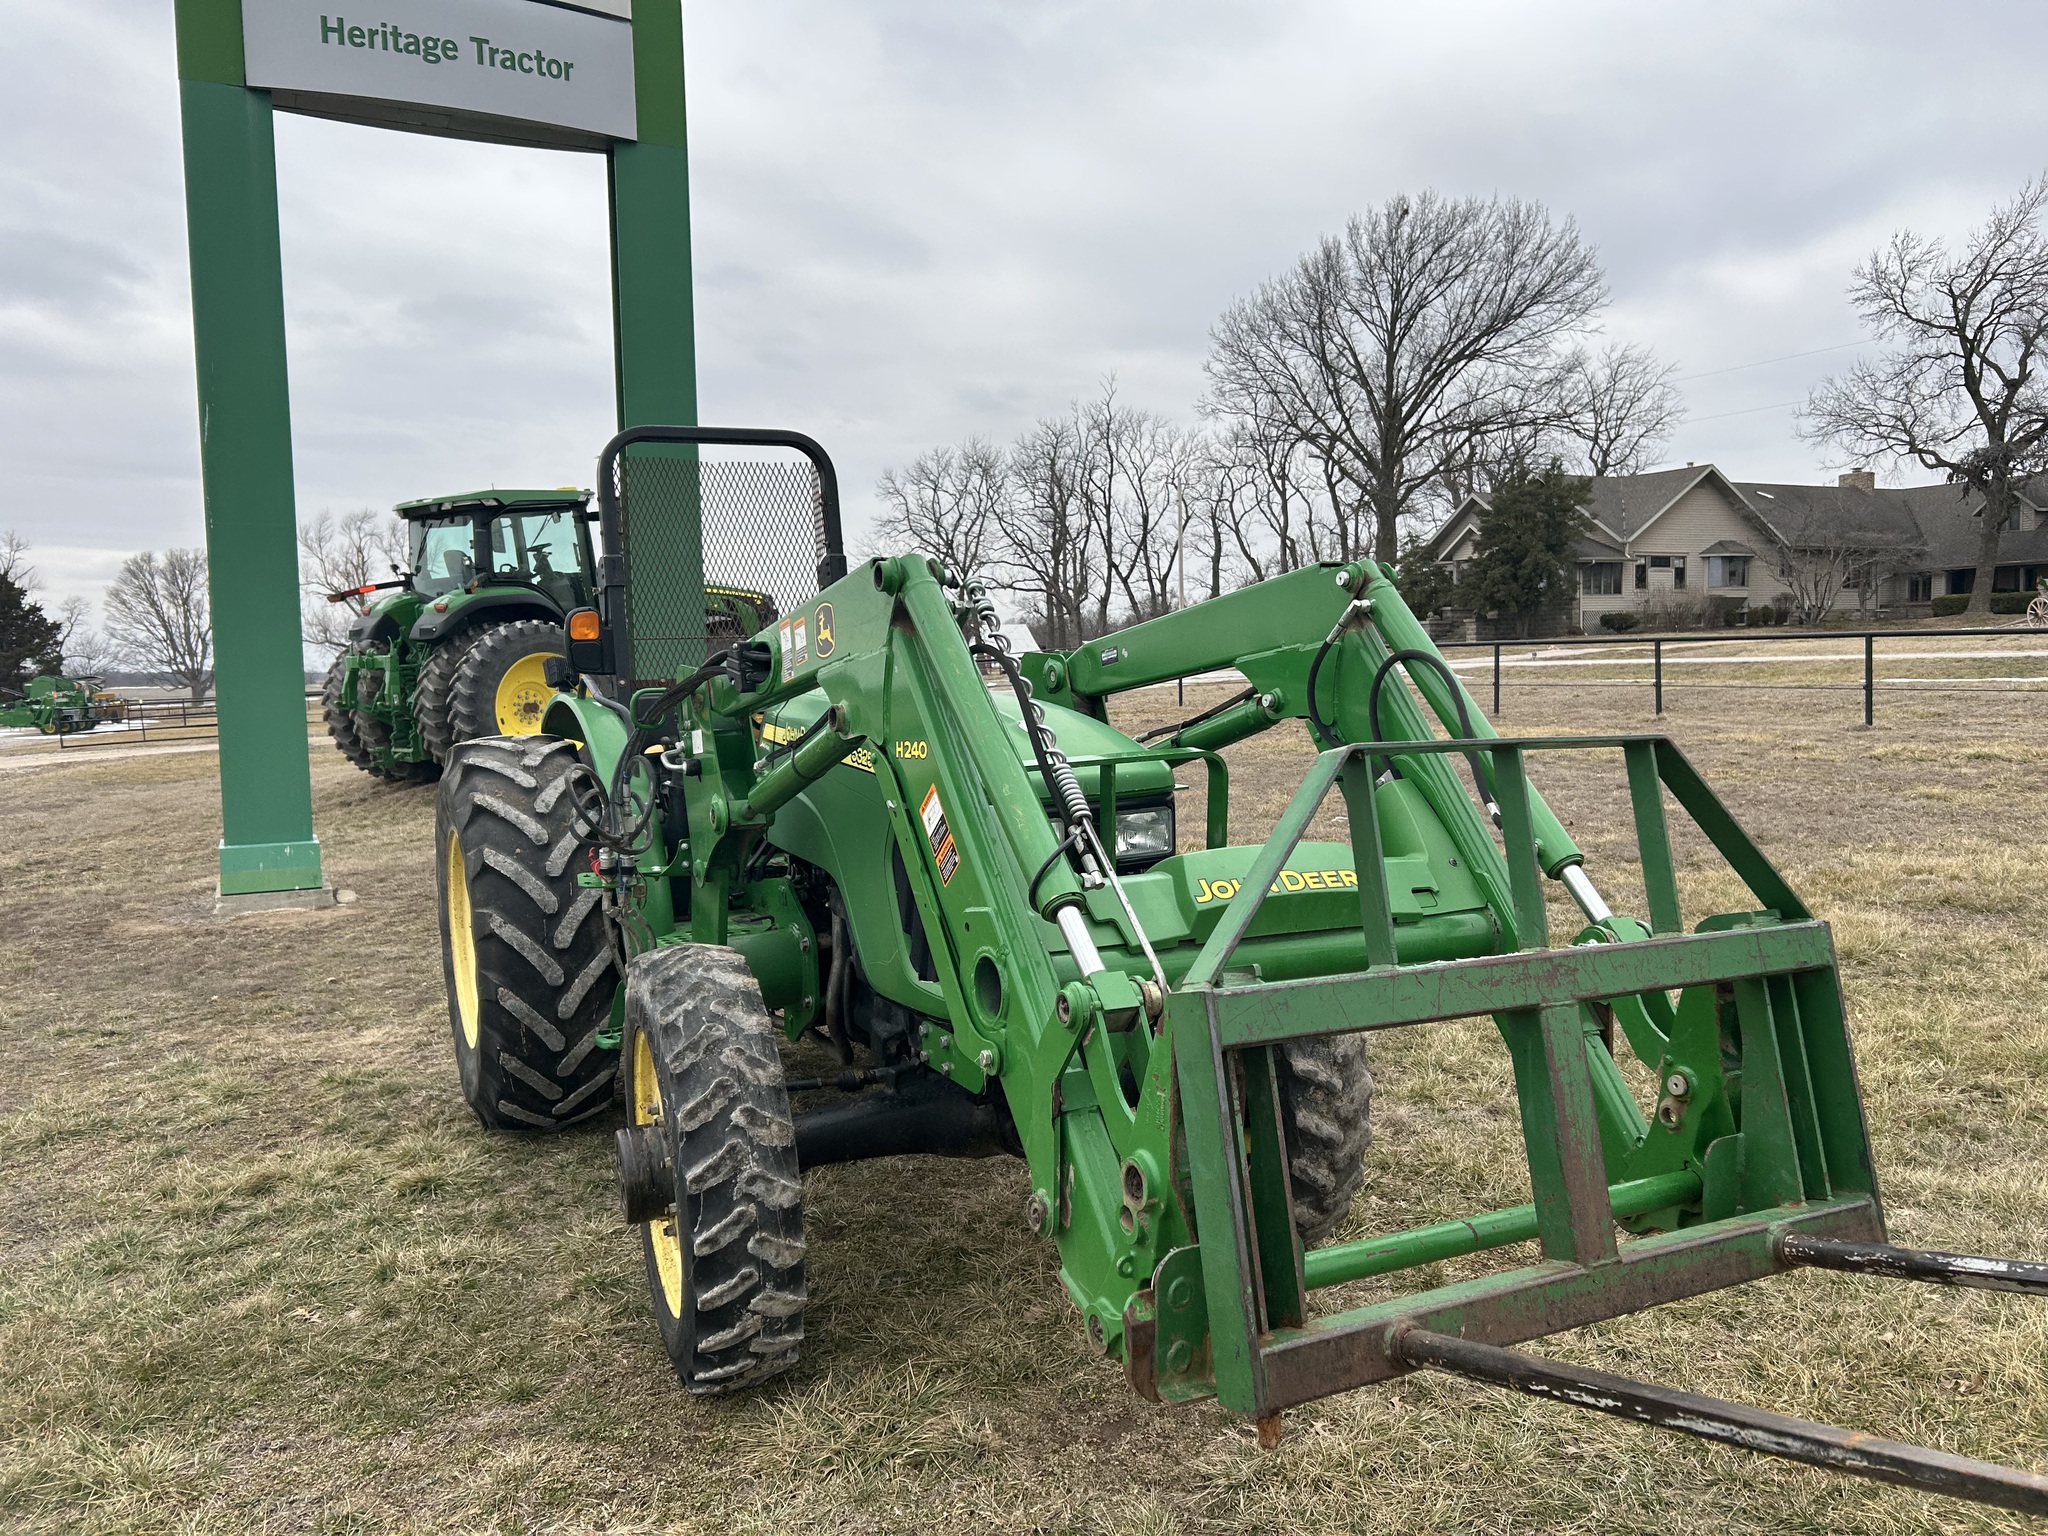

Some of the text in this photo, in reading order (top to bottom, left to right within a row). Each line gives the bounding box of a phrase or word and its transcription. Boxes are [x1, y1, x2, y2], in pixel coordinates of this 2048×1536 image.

[320, 15, 574, 82] Heritage Tractor
[895, 741, 927, 759] H240
[1278, 870, 1359, 892] DEER
